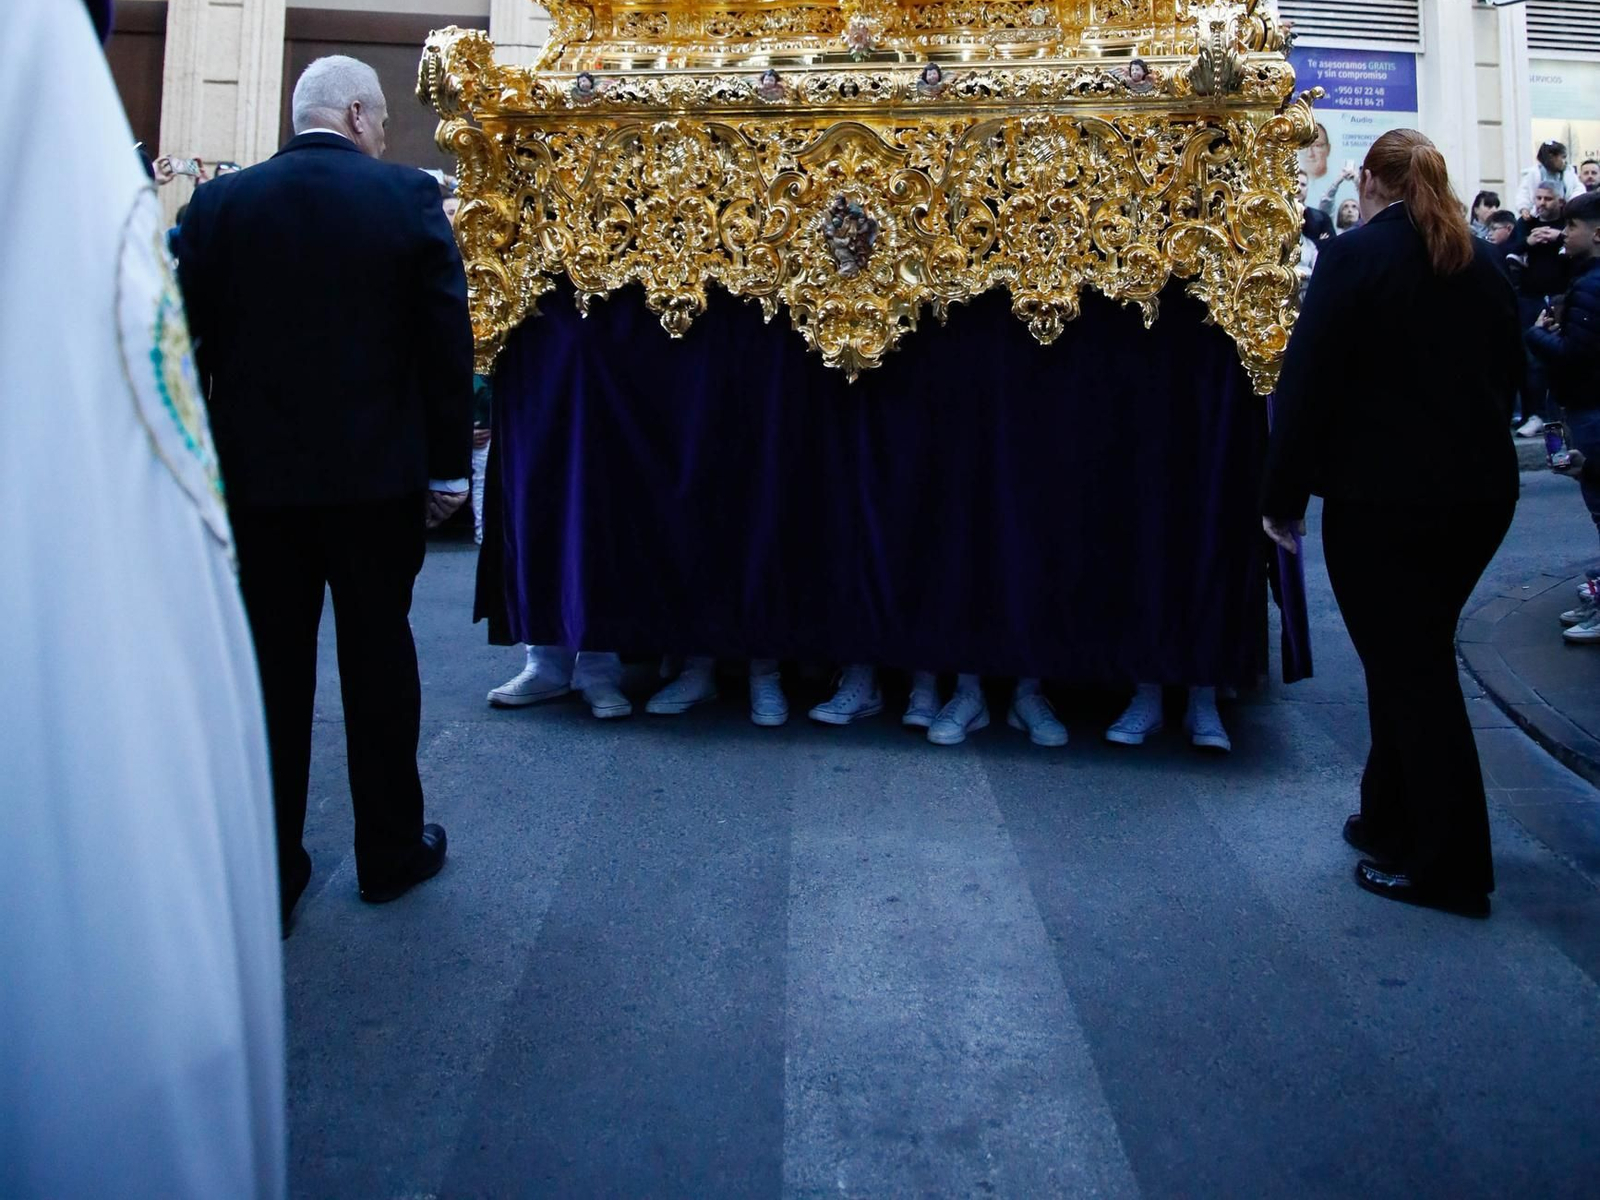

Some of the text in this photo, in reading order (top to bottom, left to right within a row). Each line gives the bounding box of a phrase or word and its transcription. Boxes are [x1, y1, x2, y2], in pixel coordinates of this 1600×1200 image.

[1308, 59, 1396, 71] Te asesoramos GRATIS
[1317, 69, 1387, 80] y sin compromiso
